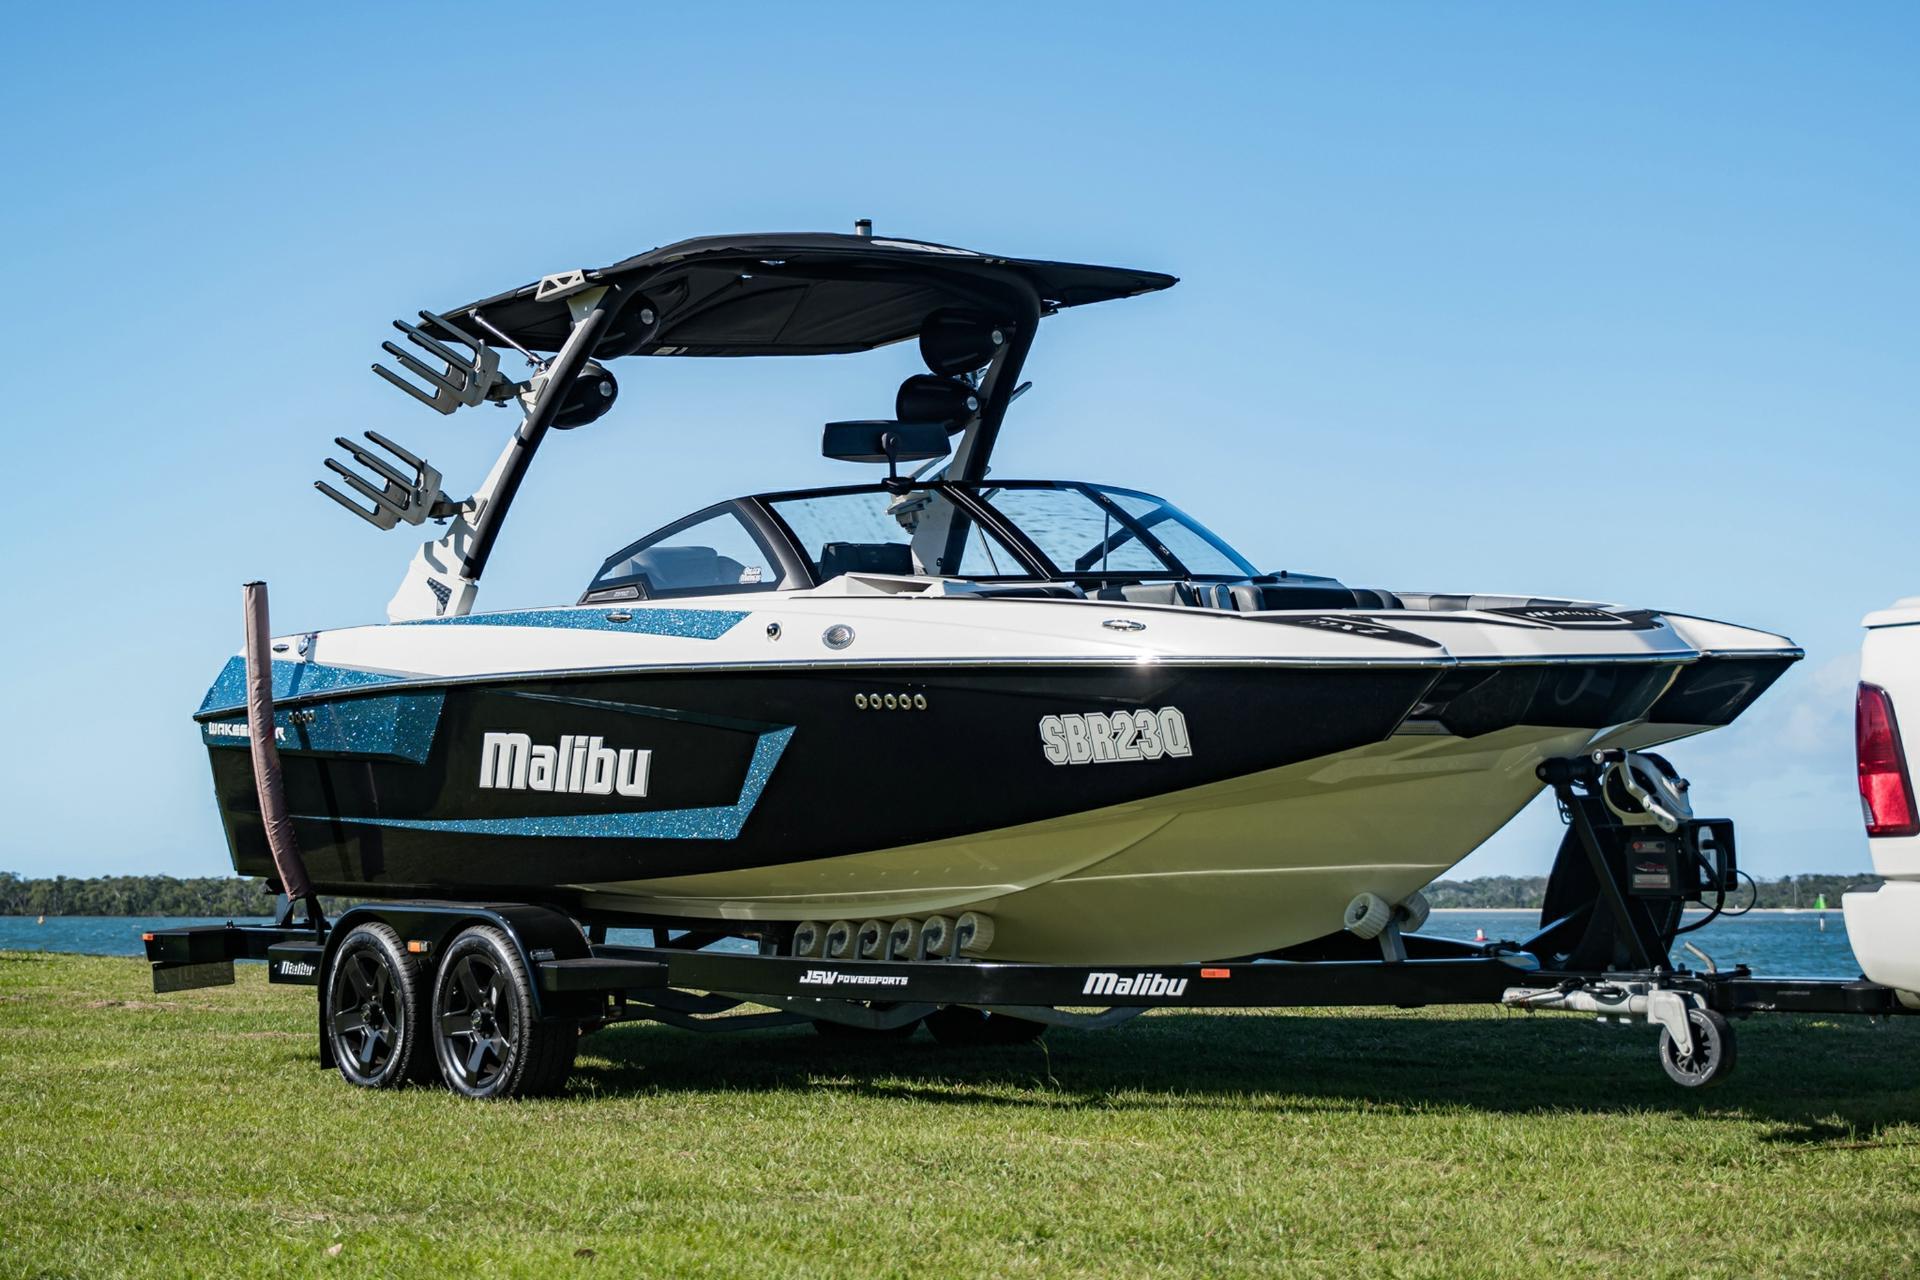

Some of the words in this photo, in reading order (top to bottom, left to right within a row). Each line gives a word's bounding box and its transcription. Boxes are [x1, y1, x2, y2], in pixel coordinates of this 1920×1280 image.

[478, 732, 653, 798] Malibu
[799, 969, 838, 985] JSW
[837, 974, 909, 986] POWERSPORTS
[1081, 971, 1189, 997] Malibu
